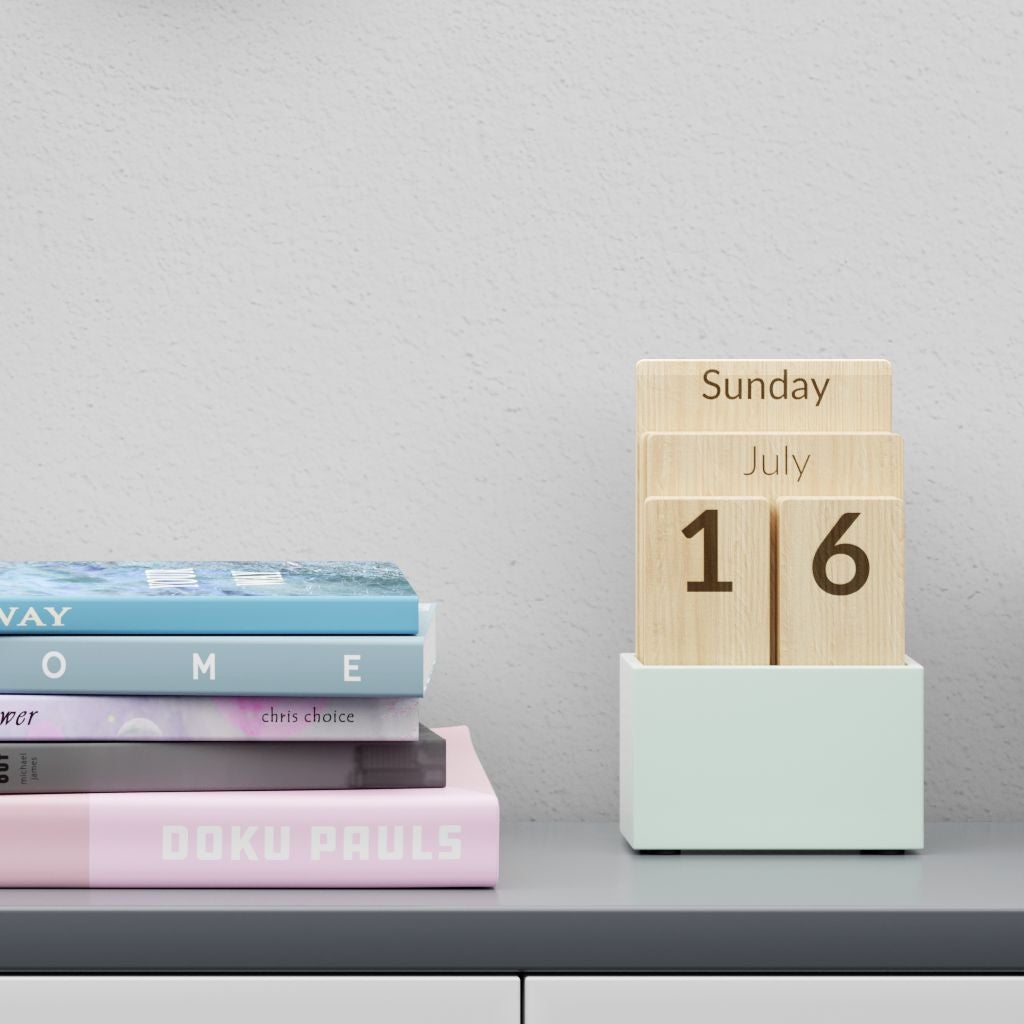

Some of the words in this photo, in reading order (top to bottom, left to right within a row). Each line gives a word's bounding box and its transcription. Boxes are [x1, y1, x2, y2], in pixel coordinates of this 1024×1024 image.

[702, 369, 830, 406] Sunday
[744, 445, 811, 482] July
[261, 706, 298, 724] chris
[304, 706, 355, 724] choice
[19, 752, 28, 784] michael
[162, 824, 290, 861] DOKU
[310, 824, 462, 861] PAULS
